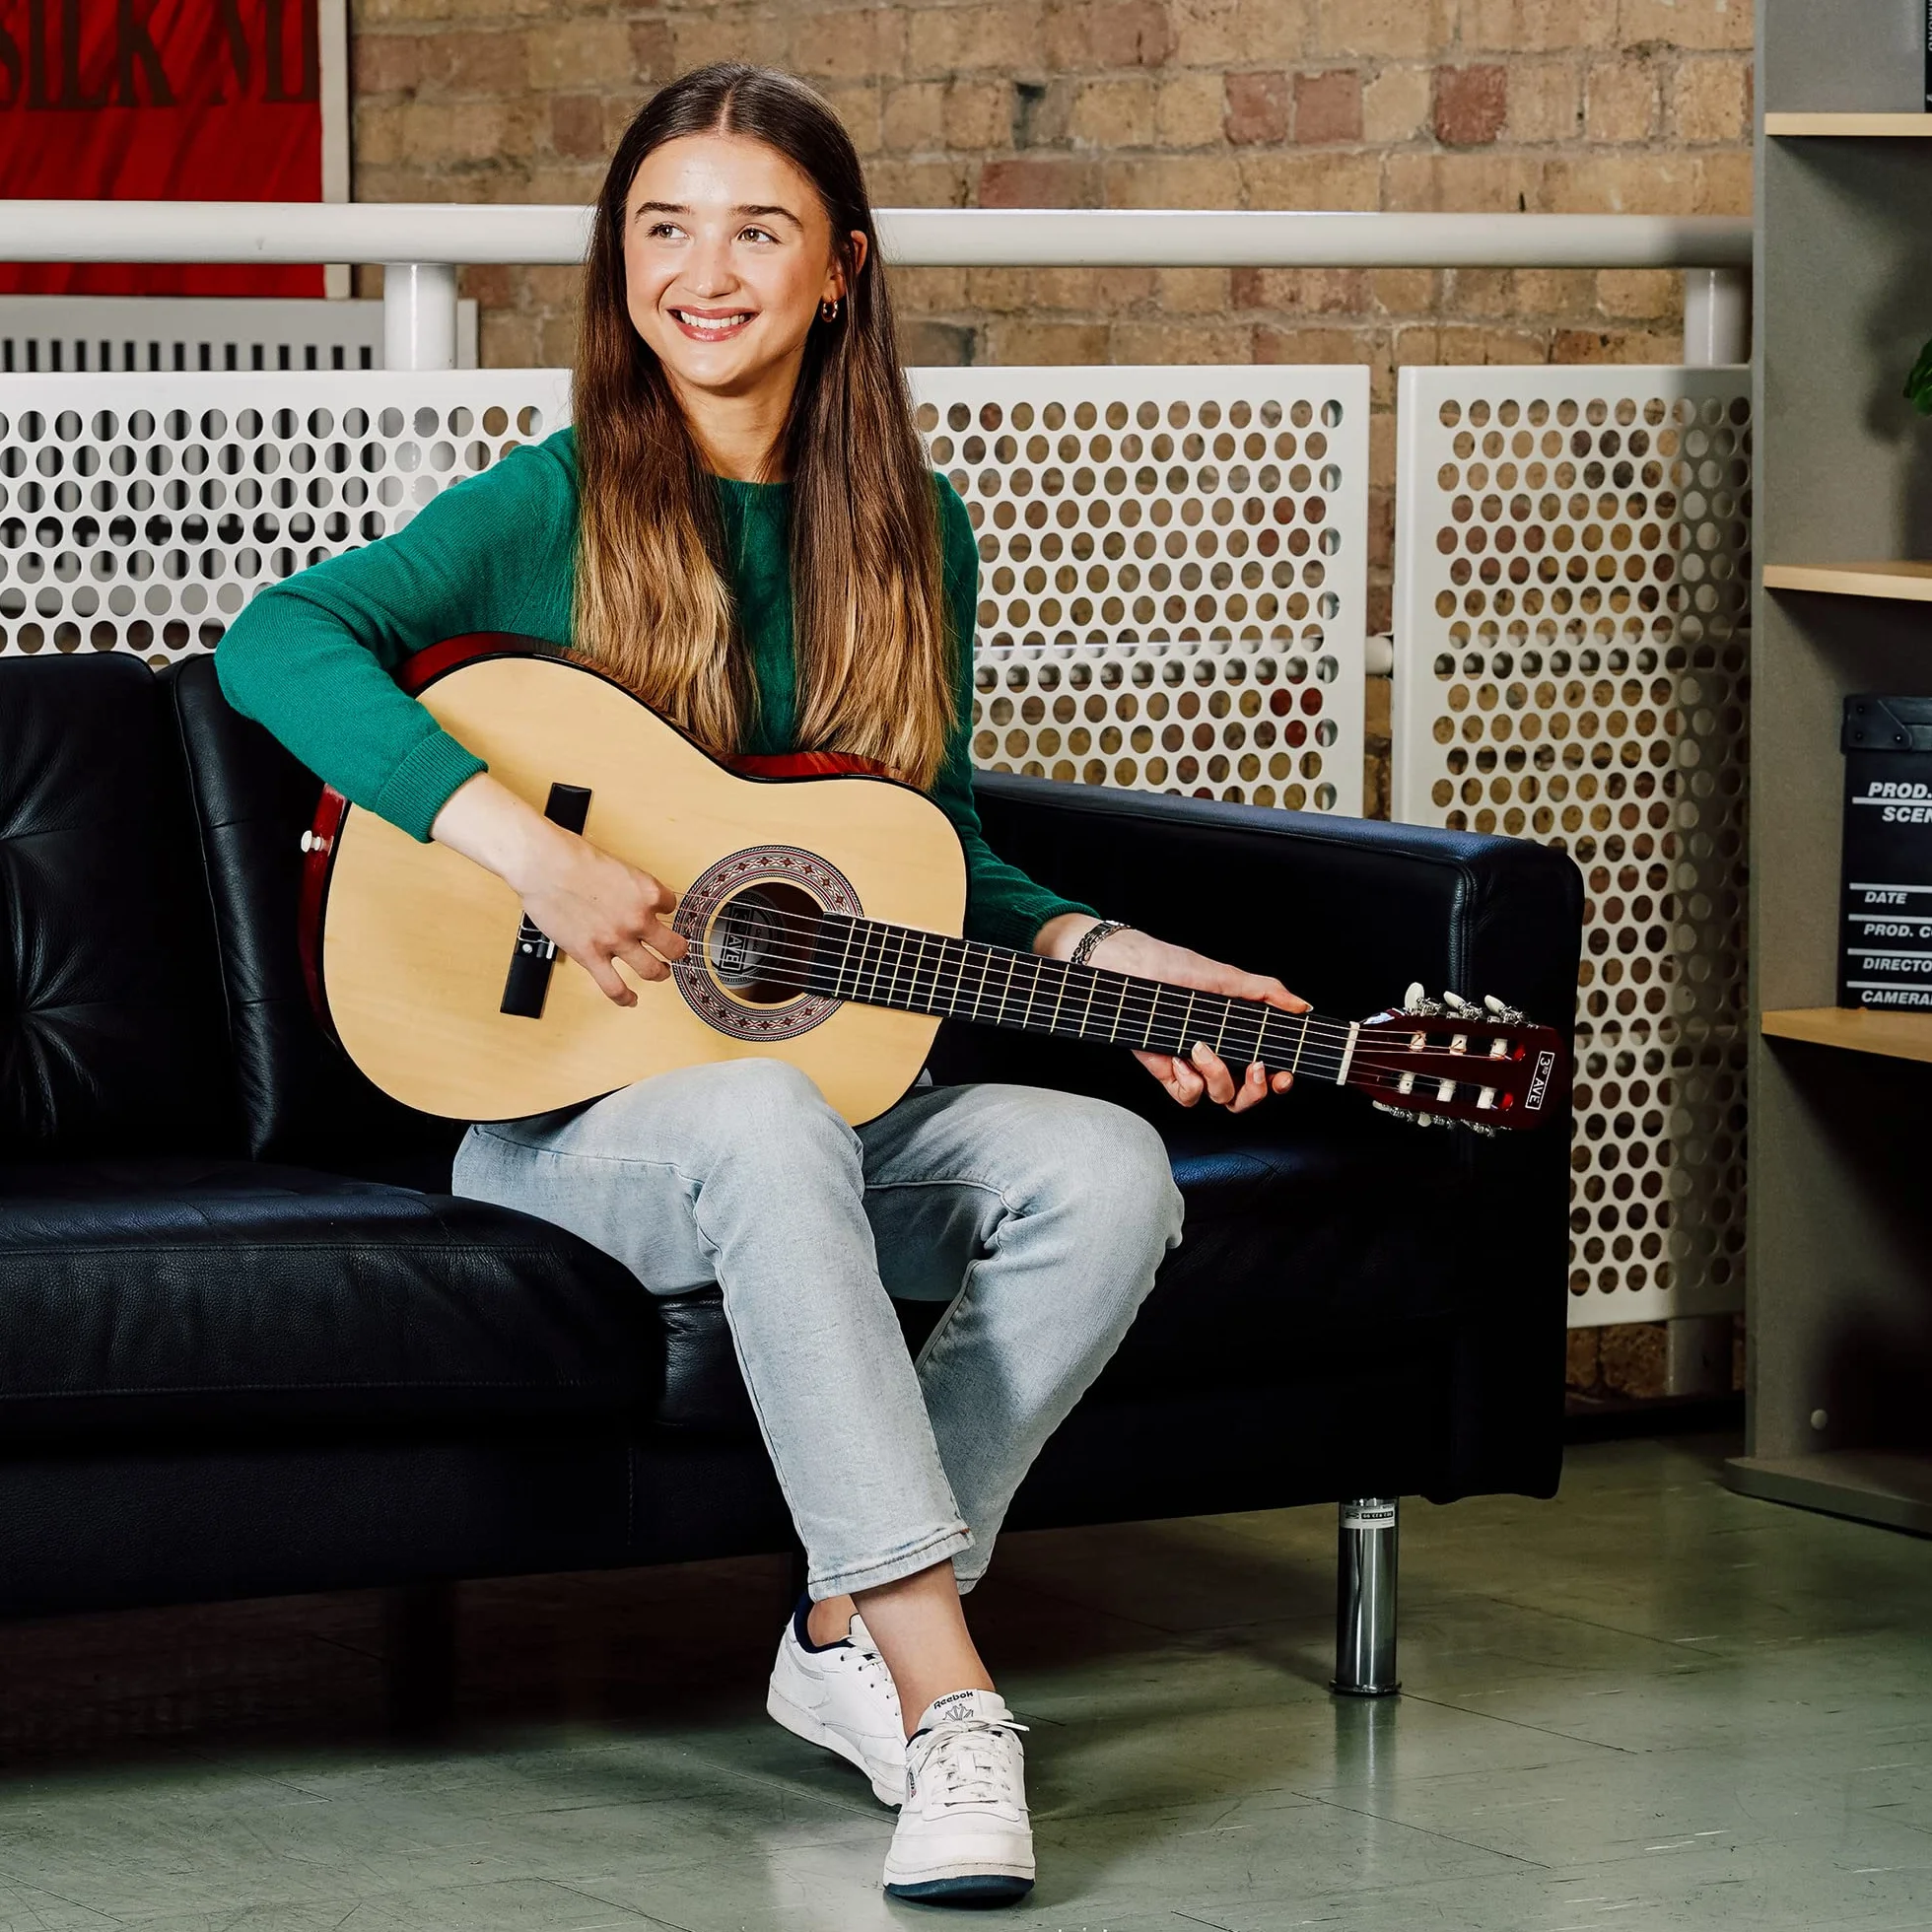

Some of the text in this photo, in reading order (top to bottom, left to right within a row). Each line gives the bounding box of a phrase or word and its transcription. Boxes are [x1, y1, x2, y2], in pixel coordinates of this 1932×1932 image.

[1868, 782, 1932, 798] PROD.
[1864, 891, 1907, 904] DATE
[1864, 924, 1932, 938] PROD. C
[1863, 957, 1932, 973] DIRECTO
[1861, 990, 1932, 1005] CAMERA
[1529, 1077, 1545, 1104] AVE
[933, 1690, 974, 1710] Reebok
